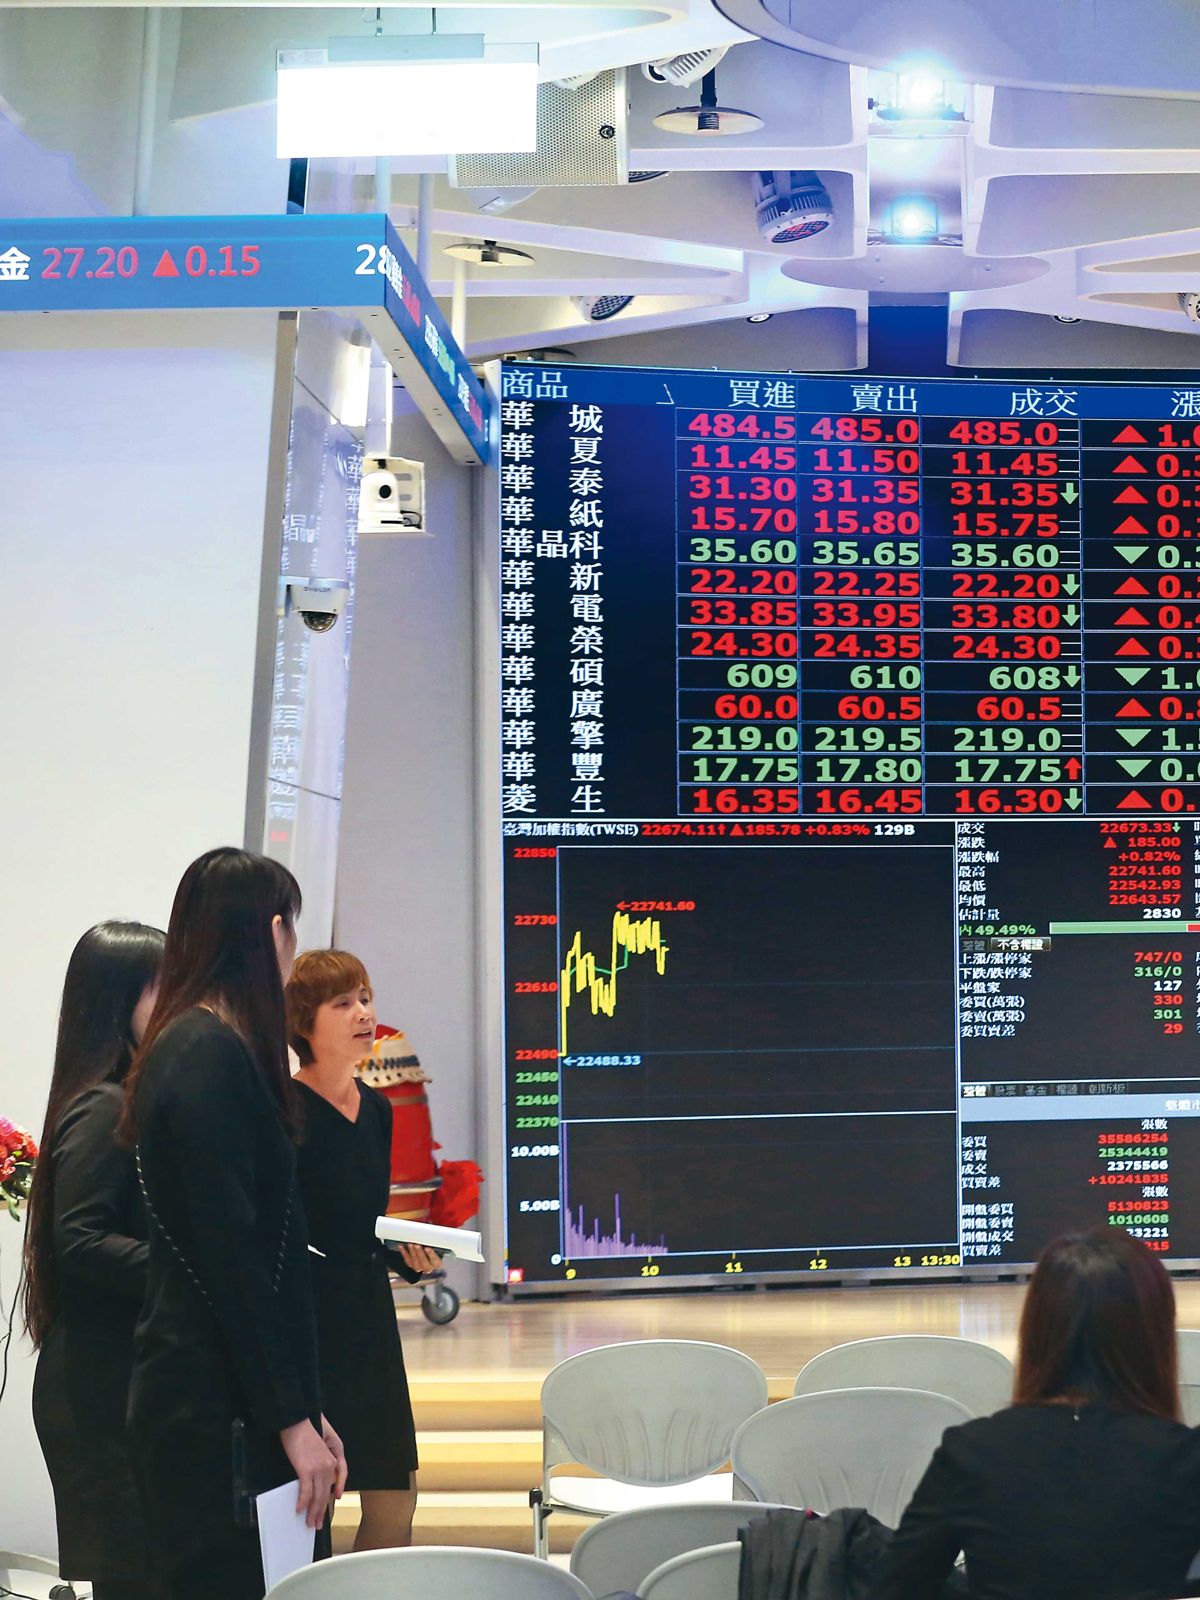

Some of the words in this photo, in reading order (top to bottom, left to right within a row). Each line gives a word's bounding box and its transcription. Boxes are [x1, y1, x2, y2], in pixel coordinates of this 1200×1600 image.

[0, 247, 30, 281] 金
[42, 247, 138, 279] 27.20
[186, 245, 260, 277] 0.15
[503, 372, 568, 399] 商品
[729, 381, 796, 409] 買進
[852, 384, 918, 412] 賣出
[1010, 390, 1078, 416] 成交
[689, 414, 796, 439] 484.5
[811, 419, 919, 443] 485.0
[949, 422, 1058, 445] 485.0
[689, 476, 796, 501] 31.30
[812, 480, 919, 505] 31.35
[950, 483, 1058, 506] 31.35
[502, 530, 603, 559] 華晶科
[690, 538, 796, 563] 35.60
[812, 542, 920, 566] 35.65
[951, 545, 1059, 567] 35.60
[691, 633, 797, 656] 24.30
[814, 634, 920, 658] 24.35
[952, 636, 1059, 659] 24.30
[727, 664, 797, 688] 609
[850, 665, 920, 689] 610
[989, 667, 1060, 690] 608
[692, 726, 798, 750] 219.0
[815, 728, 921, 751] 219.5
[954, 728, 1061, 751] 219.0
[693, 789, 798, 814] 16.35
[816, 789, 922, 813] 16.45
[956, 790, 1061, 813] 16.30
[642, 824, 719, 835] 22674.11
[746, 824, 801, 836] 185.78
[805, 824, 870, 836] +0.83%
[874, 824, 915, 835] 129B
[958, 823, 984, 834] 成交
[1100, 823, 1172, 833] 22673.33
[514, 848, 556, 858] 22850
[1109, 866, 1181, 876] 22741.60
[631, 901, 695, 911] 22741.60
[1143, 909, 1181, 918] 2830
[1134, 952, 1183, 962] 747/0
[1134, 966, 1182, 977] 316/0
[1154, 981, 1182, 991] 127
[1154, 1010, 1182, 1019] 301
[576, 1055, 641, 1066] 22488.33
[1098, 1133, 1168, 1144] 35586254
[511, 1145, 559, 1157] 10.00B
[1099, 1147, 1168, 1157] 25344419
[1107, 1160, 1168, 1171] 2375566
[1108, 1201, 1168, 1211] 5130823
[1108, 1214, 1169, 1225] 1010608
[641, 1265, 660, 1277] 10
[725, 1263, 743, 1274] 11
[809, 1259, 827, 1270] 12
[922, 1254, 960, 1265] 13:30
